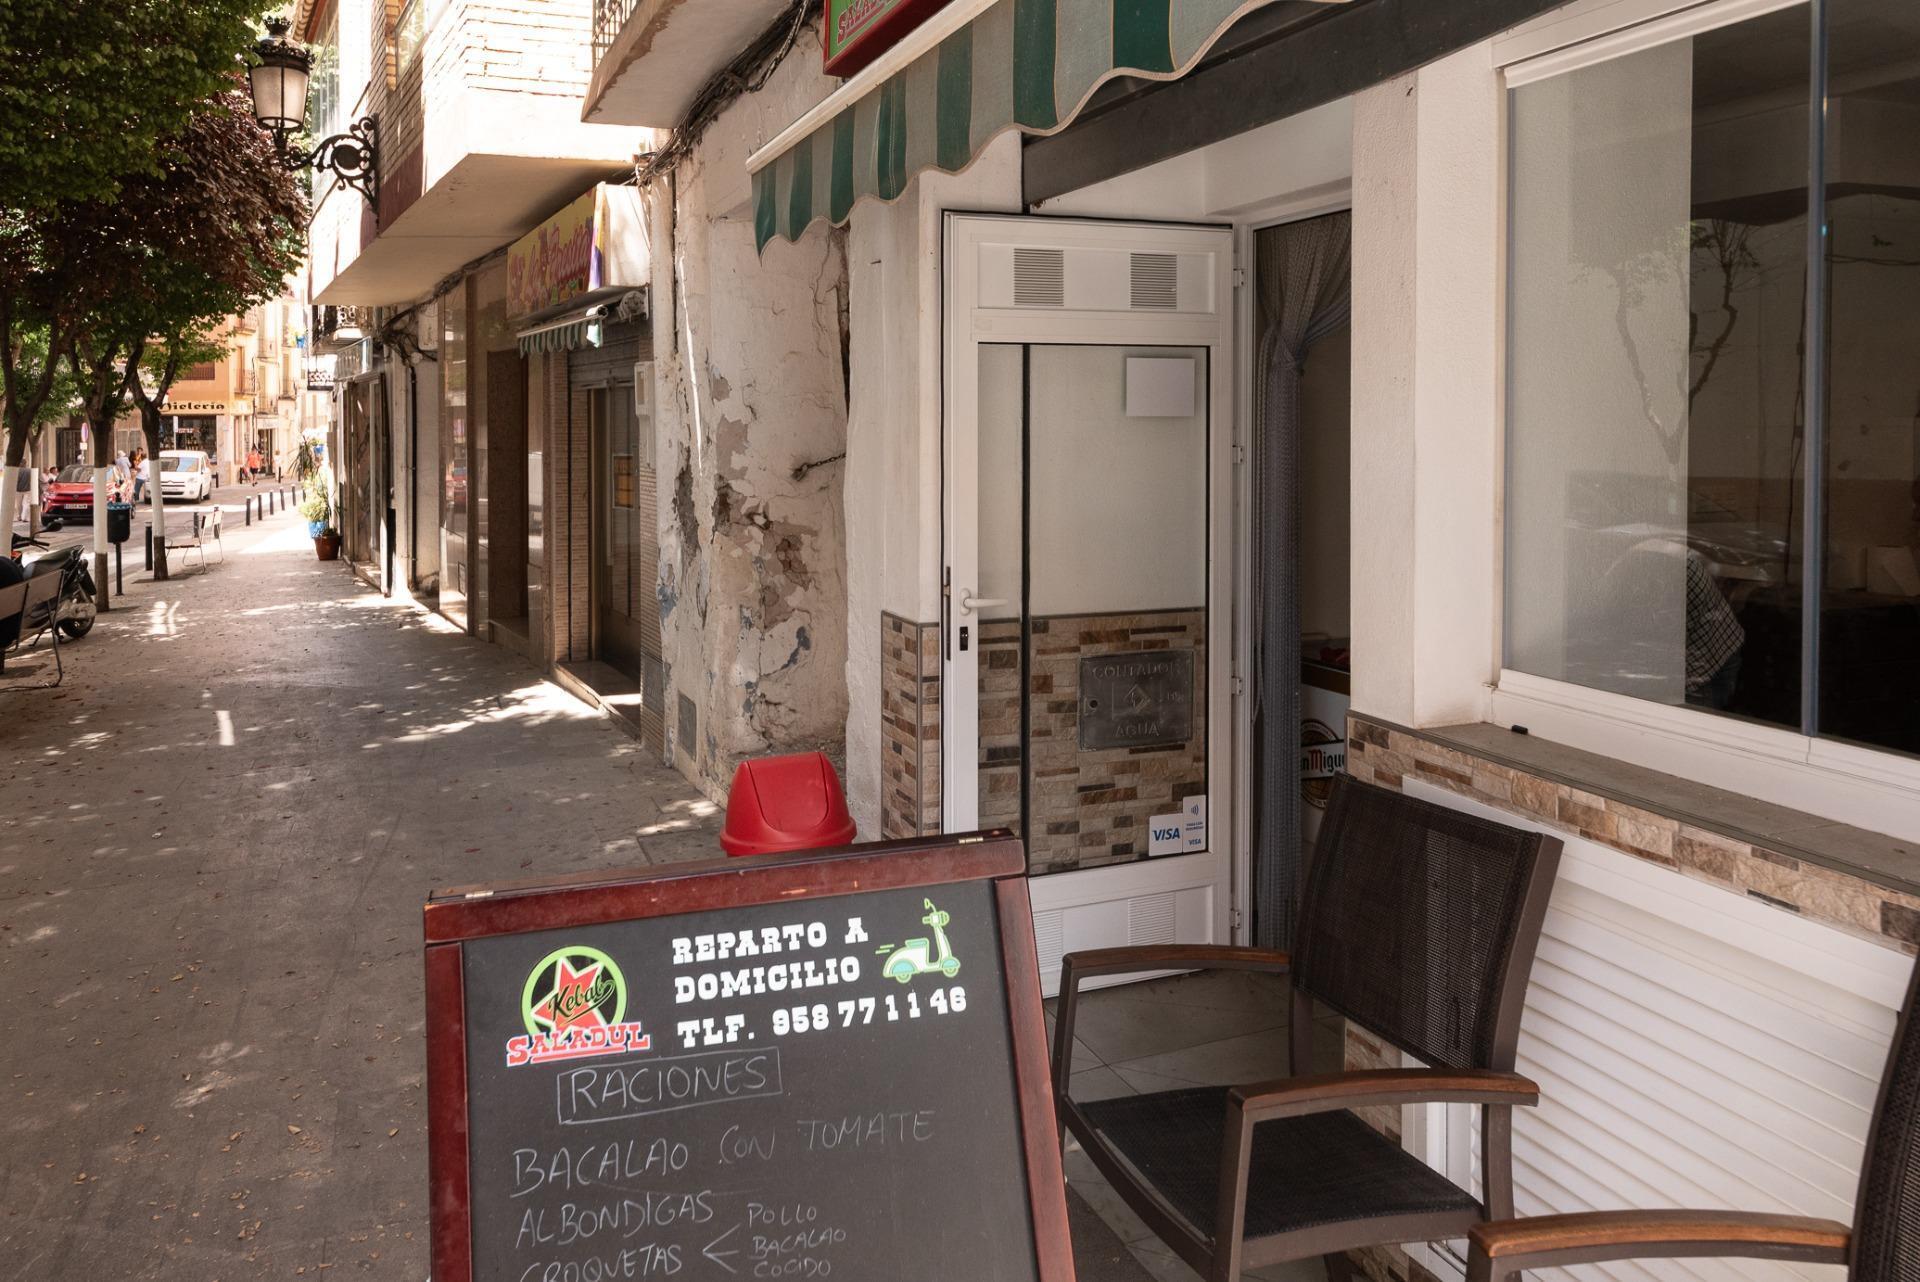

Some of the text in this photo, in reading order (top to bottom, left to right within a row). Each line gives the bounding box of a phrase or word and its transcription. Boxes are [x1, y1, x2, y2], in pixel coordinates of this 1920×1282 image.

[1113, 719, 1161, 737] AGUA
[1152, 828, 1181, 841] VISA
[1188, 838, 1202, 846] VISA
[672, 917, 869, 965] REPARTO A
[674, 956, 861, 1004] DOMICILIO
[506, 1021, 651, 1067] SALADUL
[677, 1013, 755, 1048] TLF.
[772, 1004, 829, 1036] 958
[838, 997, 876, 1028] 77
[571, 1056, 767, 1114] RACIONES
[510, 1111, 935, 1198] BACALAO CON TOMATE
[516, 1190, 713, 1248] ALBONDIGAS
[747, 1203, 817, 1228] POLLO
[750, 1227, 847, 1259] BACALAO
[754, 1257, 832, 1278] COCIDO
